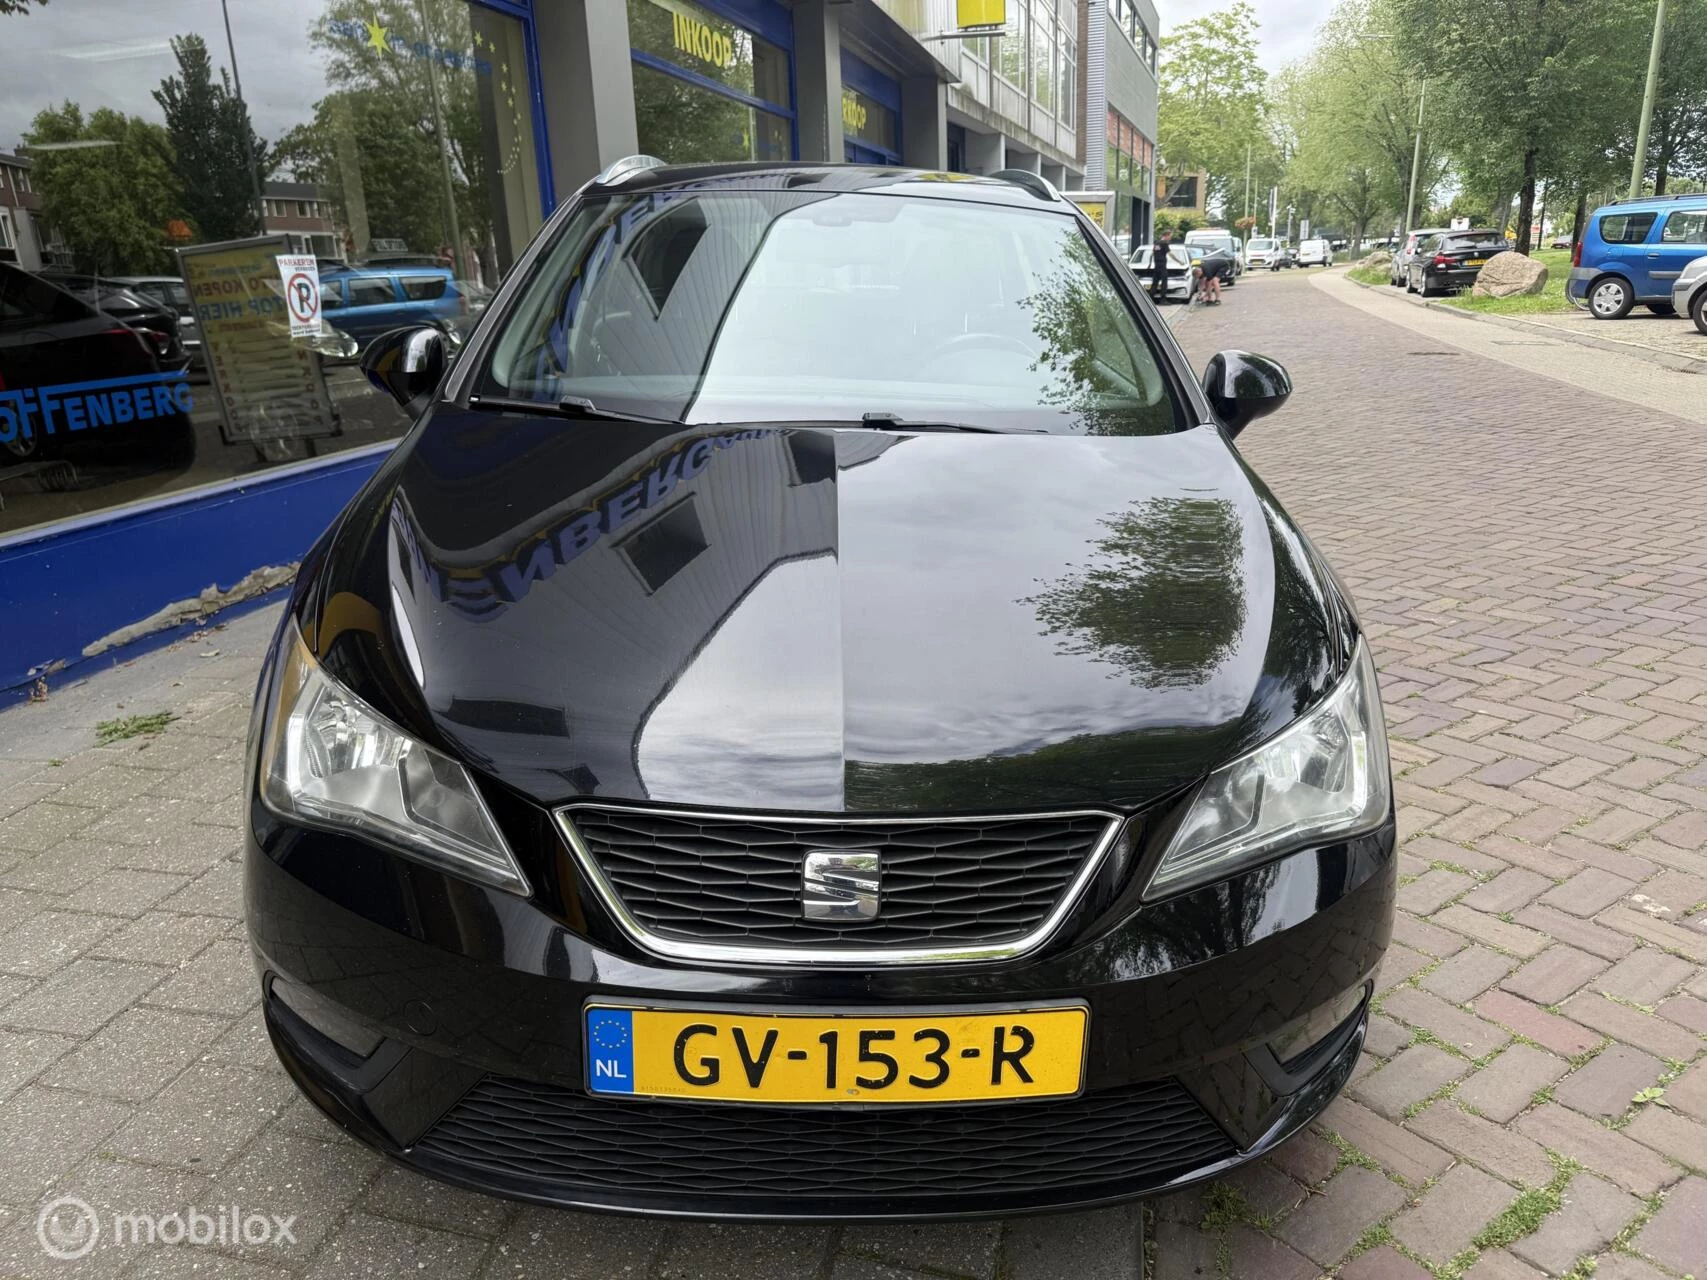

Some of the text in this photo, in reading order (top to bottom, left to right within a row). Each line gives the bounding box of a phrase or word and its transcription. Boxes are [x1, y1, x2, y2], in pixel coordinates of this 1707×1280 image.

[672, 11, 732, 69] INKOOP
[596, 1059, 627, 1078] NL
[673, 1023, 1035, 1089] GV-153-R
